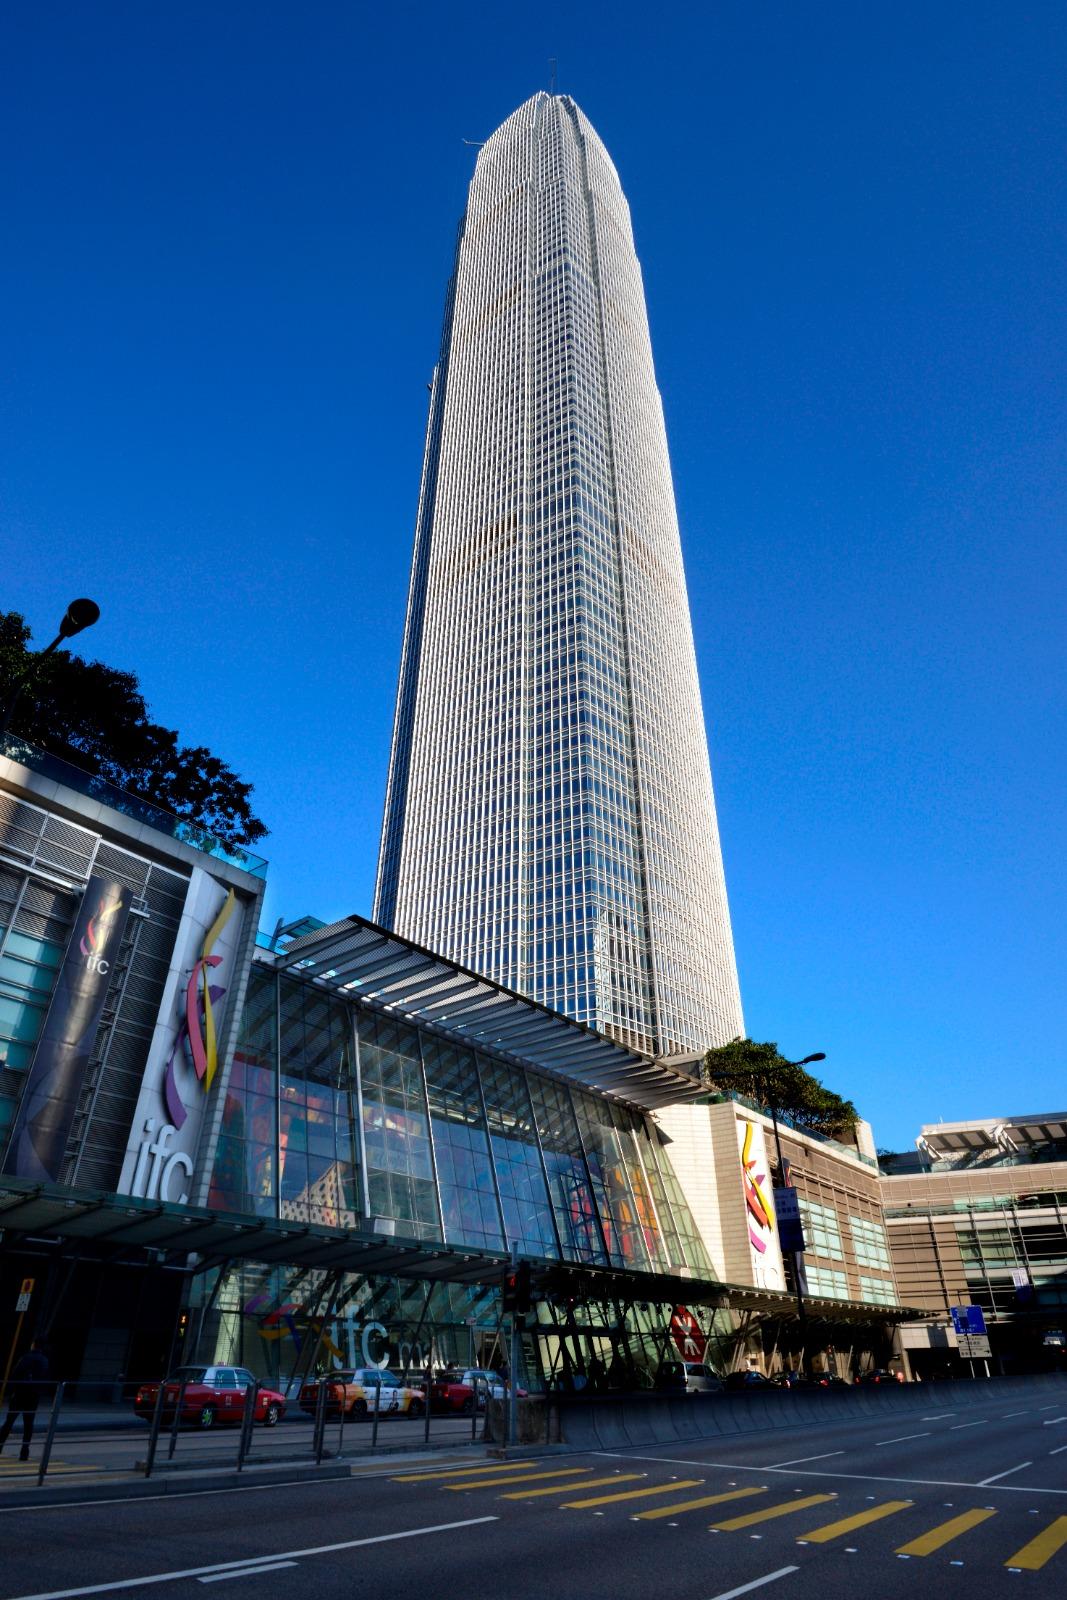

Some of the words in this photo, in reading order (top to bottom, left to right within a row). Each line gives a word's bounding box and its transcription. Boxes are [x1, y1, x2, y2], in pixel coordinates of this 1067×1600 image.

[86, 952, 110, 975] ifc
[132, 1118, 194, 1204] ifc
[330, 1303, 391, 1370] ifc
